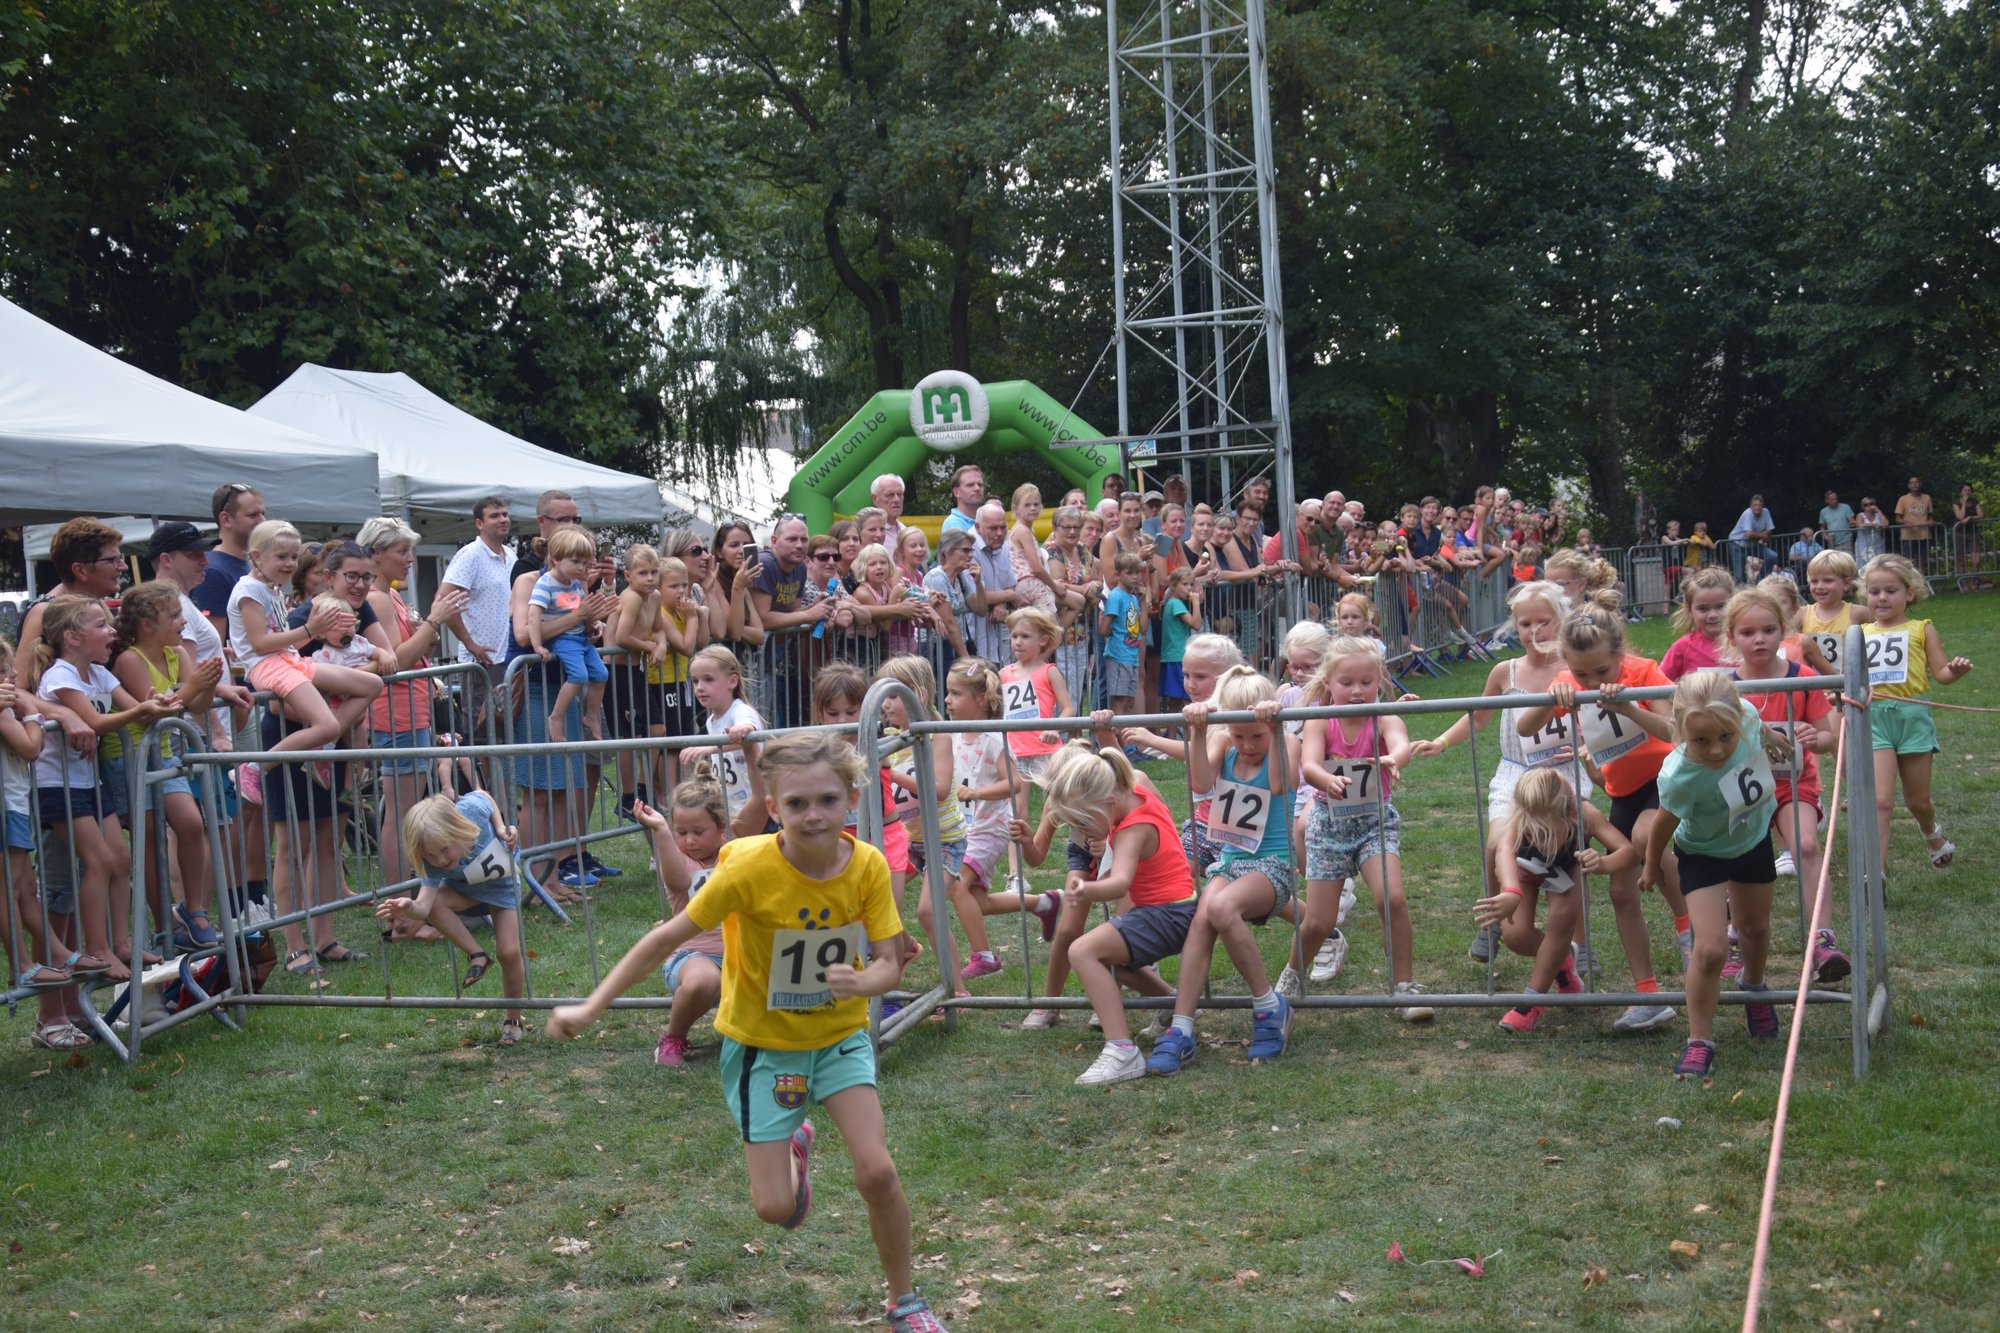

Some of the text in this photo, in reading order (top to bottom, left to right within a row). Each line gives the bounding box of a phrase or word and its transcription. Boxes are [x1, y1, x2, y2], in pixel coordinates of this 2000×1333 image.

[804, 411, 887, 488] www.cm.be
[1866, 637, 1903, 666] 25
[1007, 679, 1037, 711] 24
[1598, 706, 1624, 738] 1
[1333, 764, 1372, 799] 17
[1738, 767, 1763, 806] 6
[1218, 787, 1263, 831] 12
[480, 853, 505, 879] 5
[781, 937, 847, 985] 19
